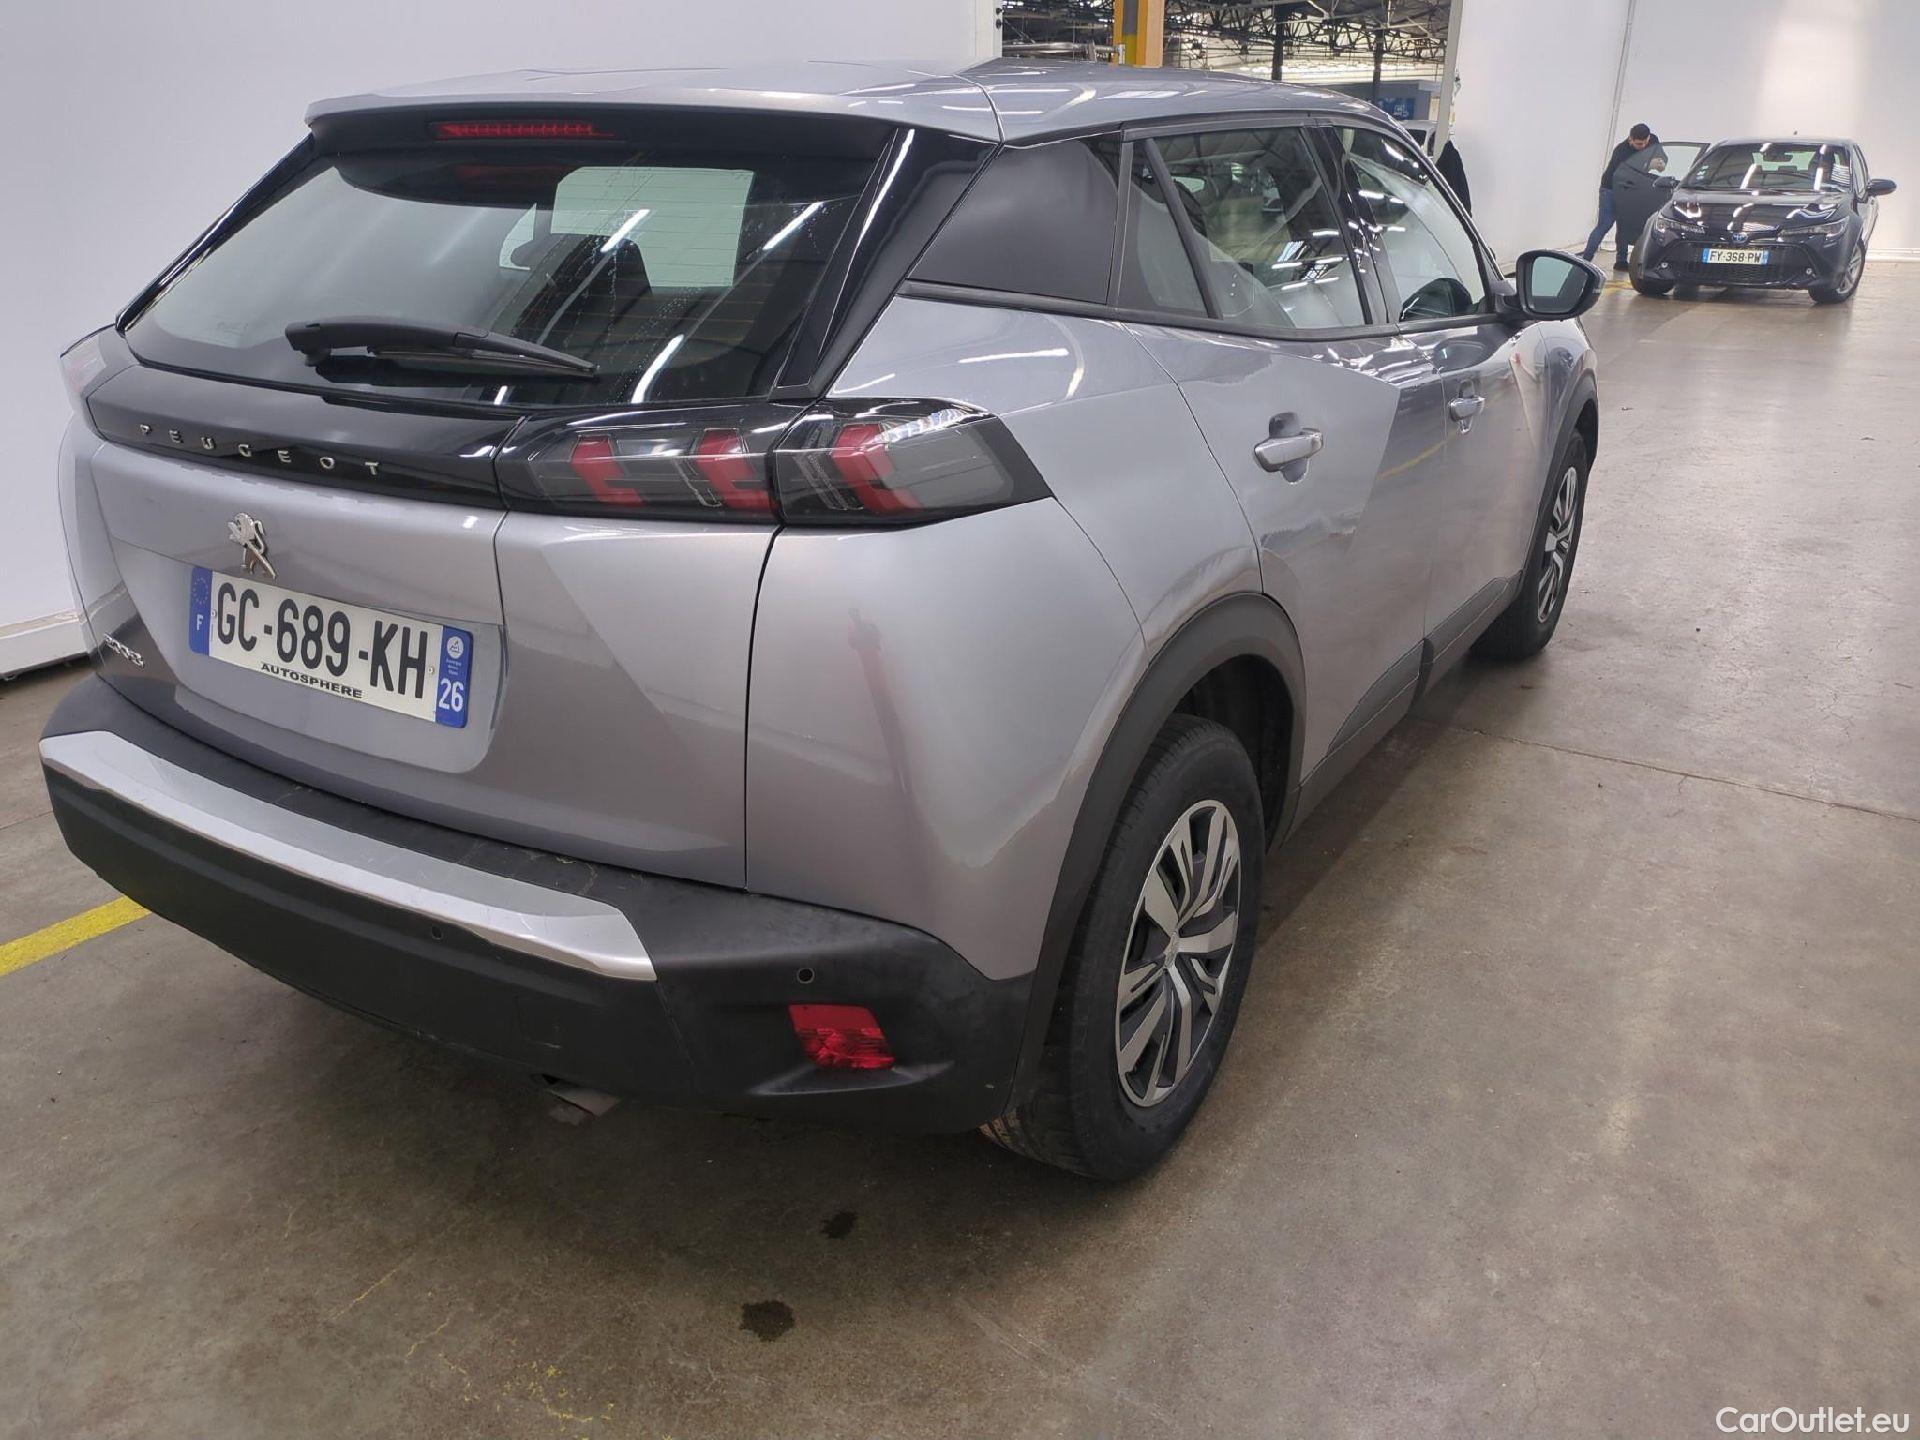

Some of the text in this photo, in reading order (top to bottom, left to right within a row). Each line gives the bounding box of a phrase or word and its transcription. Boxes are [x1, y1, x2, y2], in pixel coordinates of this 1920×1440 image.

[139, 424, 379, 475] PEUGEOT
[196, 613, 204, 631] F
[217, 582, 429, 699] GC-689-KH
[261, 662, 364, 699] AUTOSPHERE
[438, 677, 464, 713] 26
